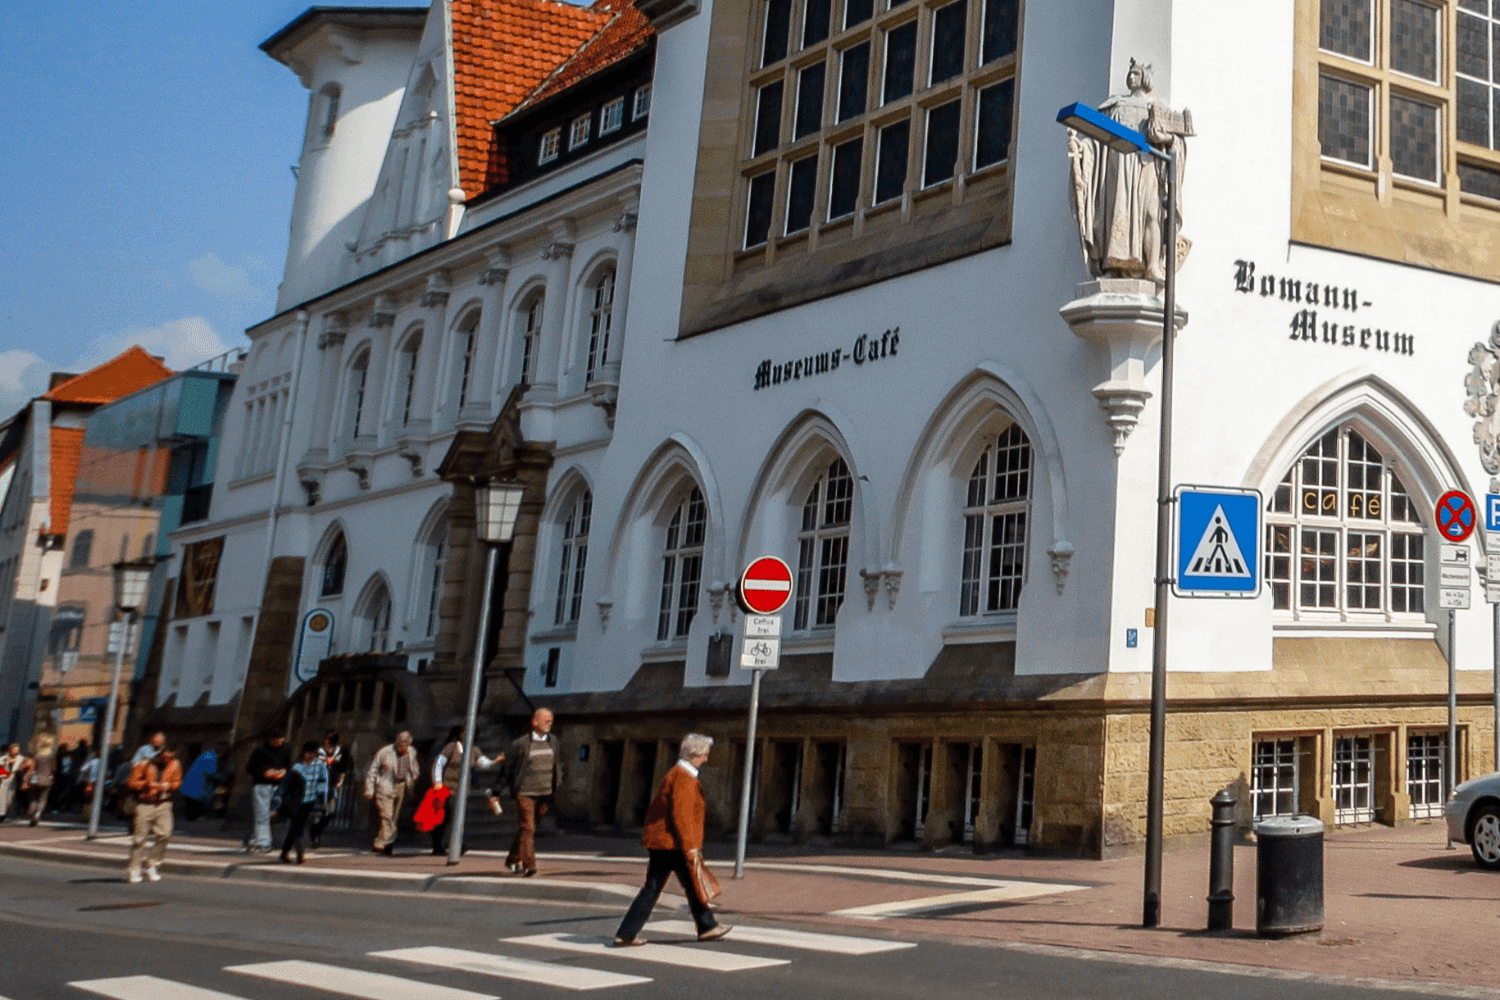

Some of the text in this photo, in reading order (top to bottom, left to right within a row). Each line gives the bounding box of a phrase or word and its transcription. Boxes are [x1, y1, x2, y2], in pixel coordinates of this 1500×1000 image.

[1233, 259, 1373, 313] Bomann-
[1289, 308, 1415, 357] Museum
[753, 326, 900, 391] Museums-Café
[1304, 492, 1380, 517] café
